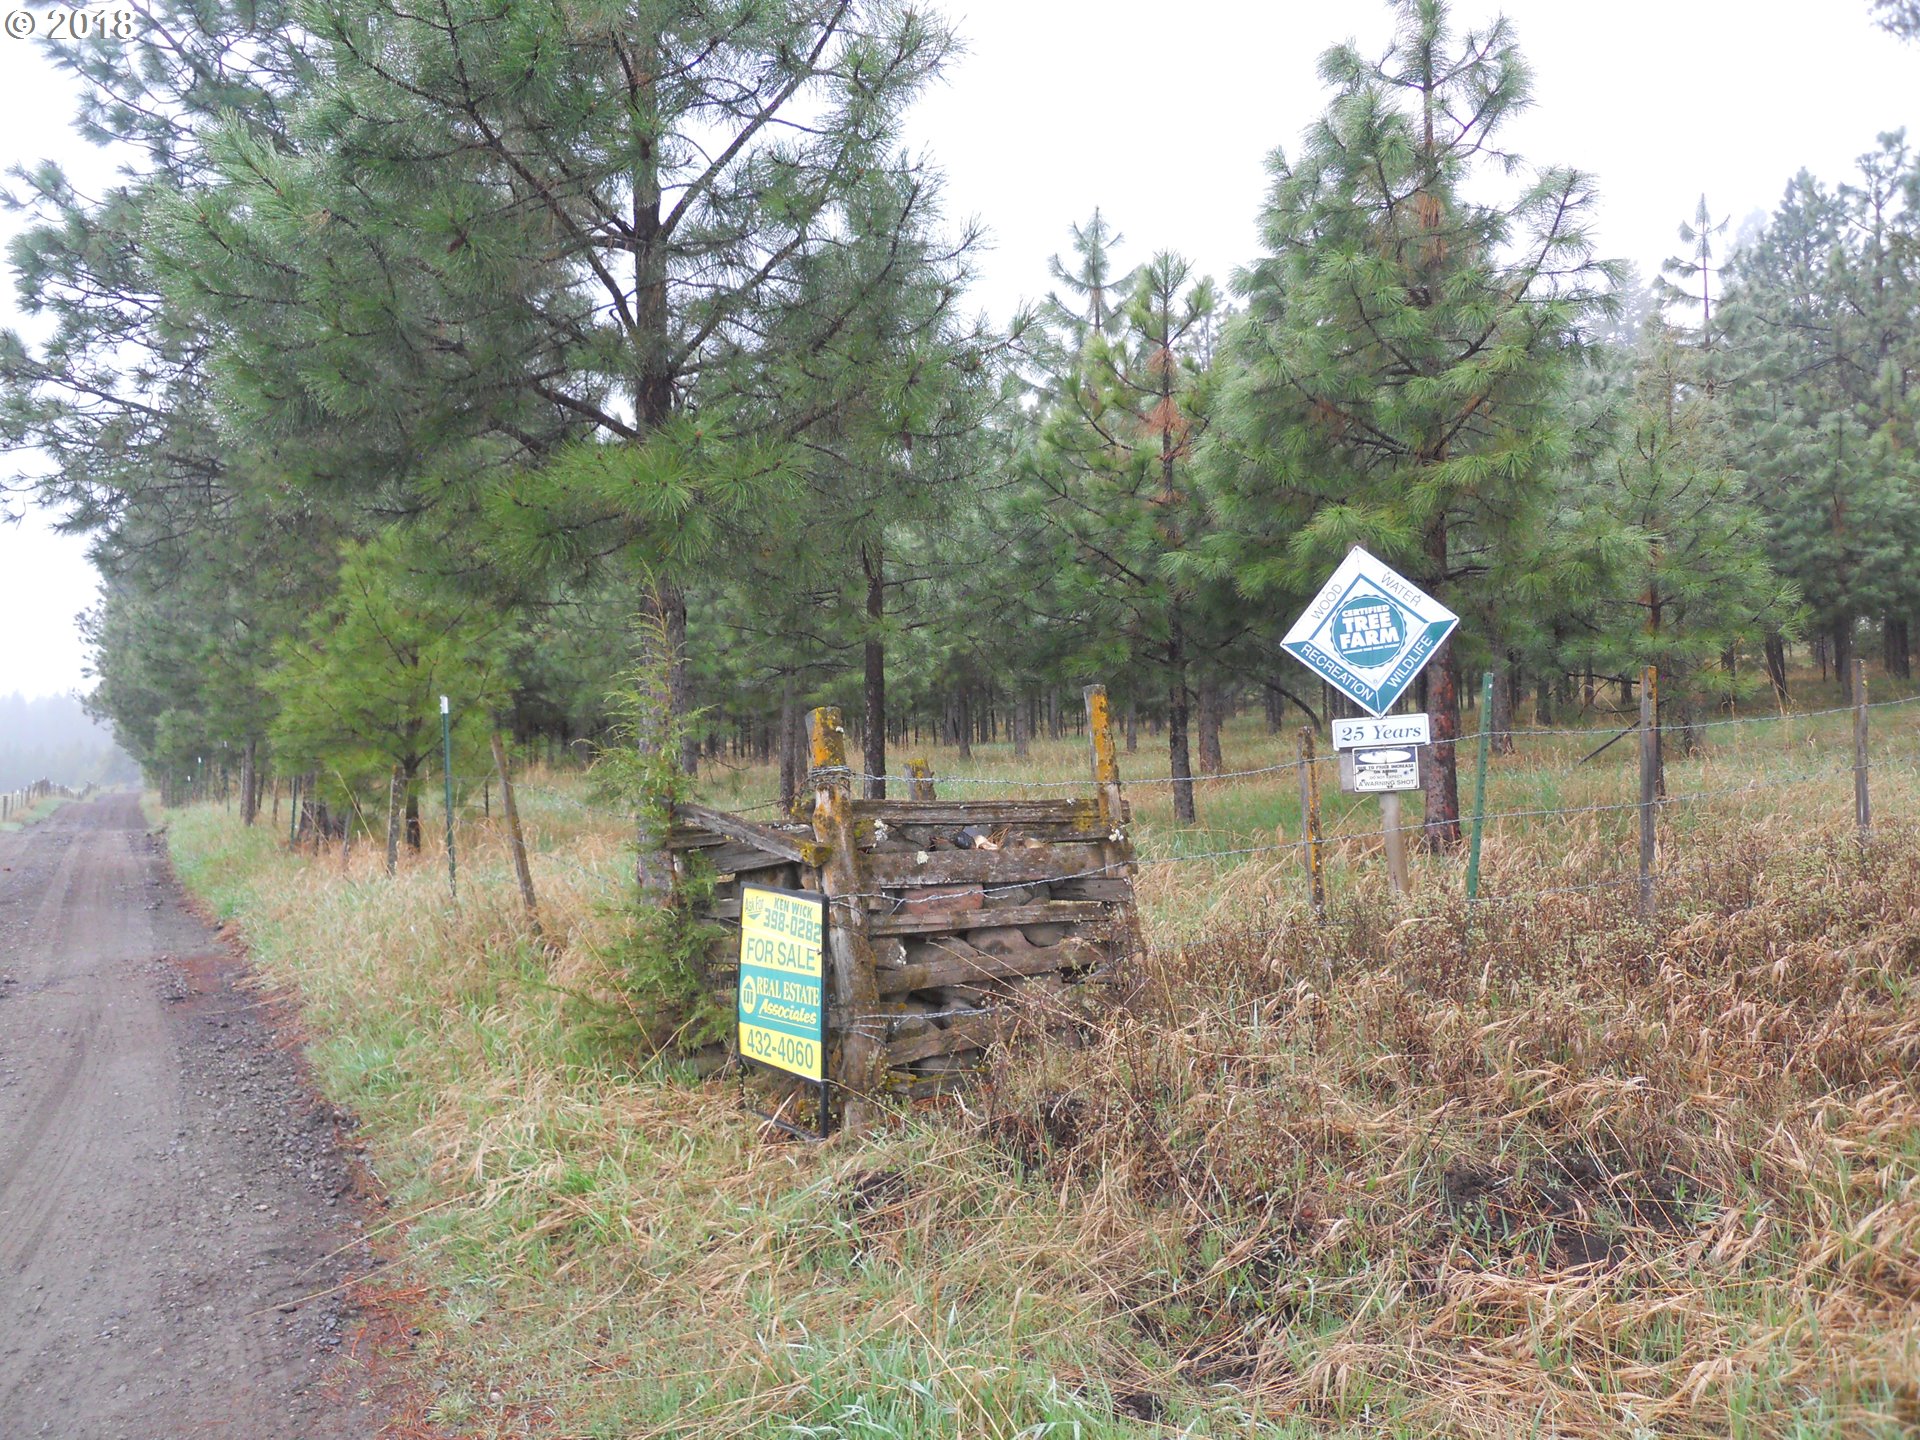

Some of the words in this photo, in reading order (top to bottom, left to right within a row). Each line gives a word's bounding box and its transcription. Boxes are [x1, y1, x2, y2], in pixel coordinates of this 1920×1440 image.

[1311, 583, 1343, 621] WOOD
[1380, 570, 1422, 607] WATER
[1341, 604, 1390, 618] CERTIFIED
[1341, 612, 1392, 634] TREE
[1339, 627, 1400, 650] FARM
[1300, 645, 1375, 702] RECREATION
[1386, 633, 1435, 689] WILDLIFE
[1341, 726, 1364, 742] 25
[1373, 723, 1422, 740] Years
[774, 897, 790, 913] KEN
[791, 902, 813, 919] WICK
[763, 907, 822, 944] 398-0282
[747, 937, 774, 964] FOR
[777, 941, 816, 971] SALE
[756, 976, 782, 999] REAL
[783, 983, 820, 1007] ESTATE
[758, 998, 817, 1025] Associates
[747, 1029, 814, 1070] 432-4060
